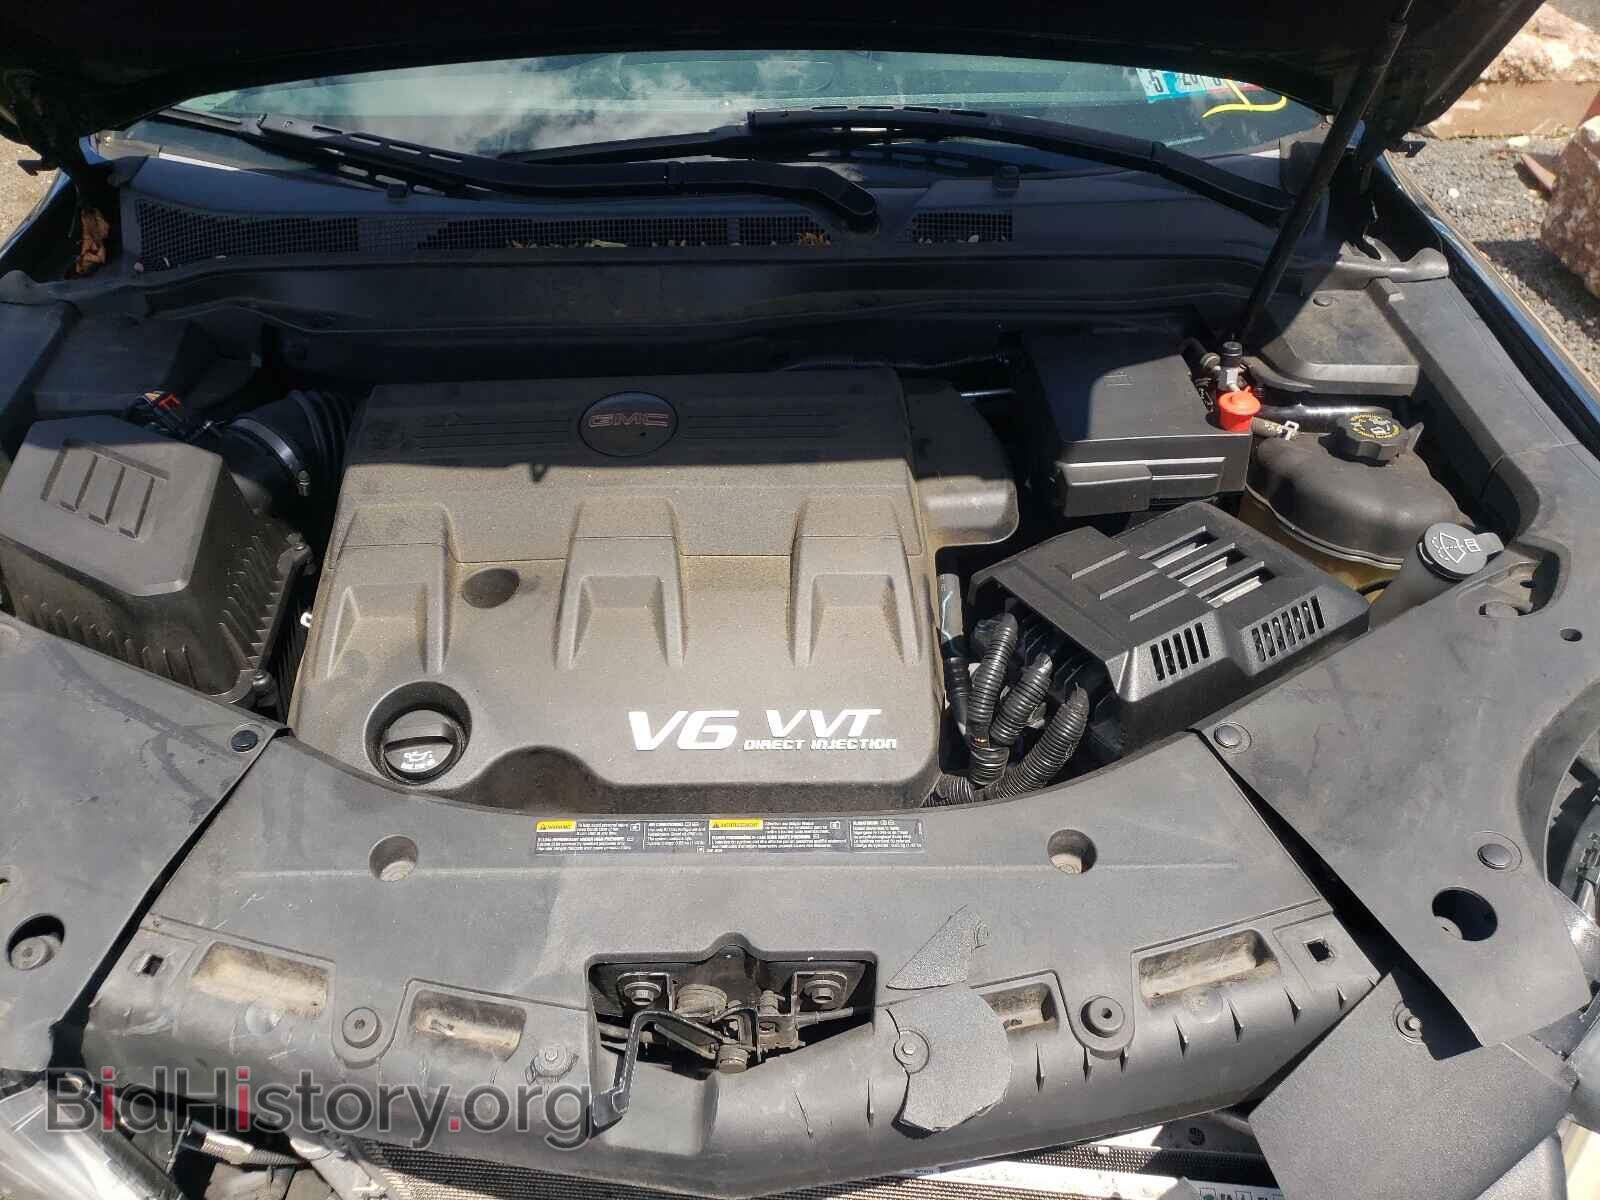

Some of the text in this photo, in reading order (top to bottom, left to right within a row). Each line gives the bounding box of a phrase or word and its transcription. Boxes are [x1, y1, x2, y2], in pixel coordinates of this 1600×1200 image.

[588, 412, 670, 429] GMC
[628, 708, 882, 751] V6 VVT
[742, 738, 897, 750] DIRECT INJECTION
